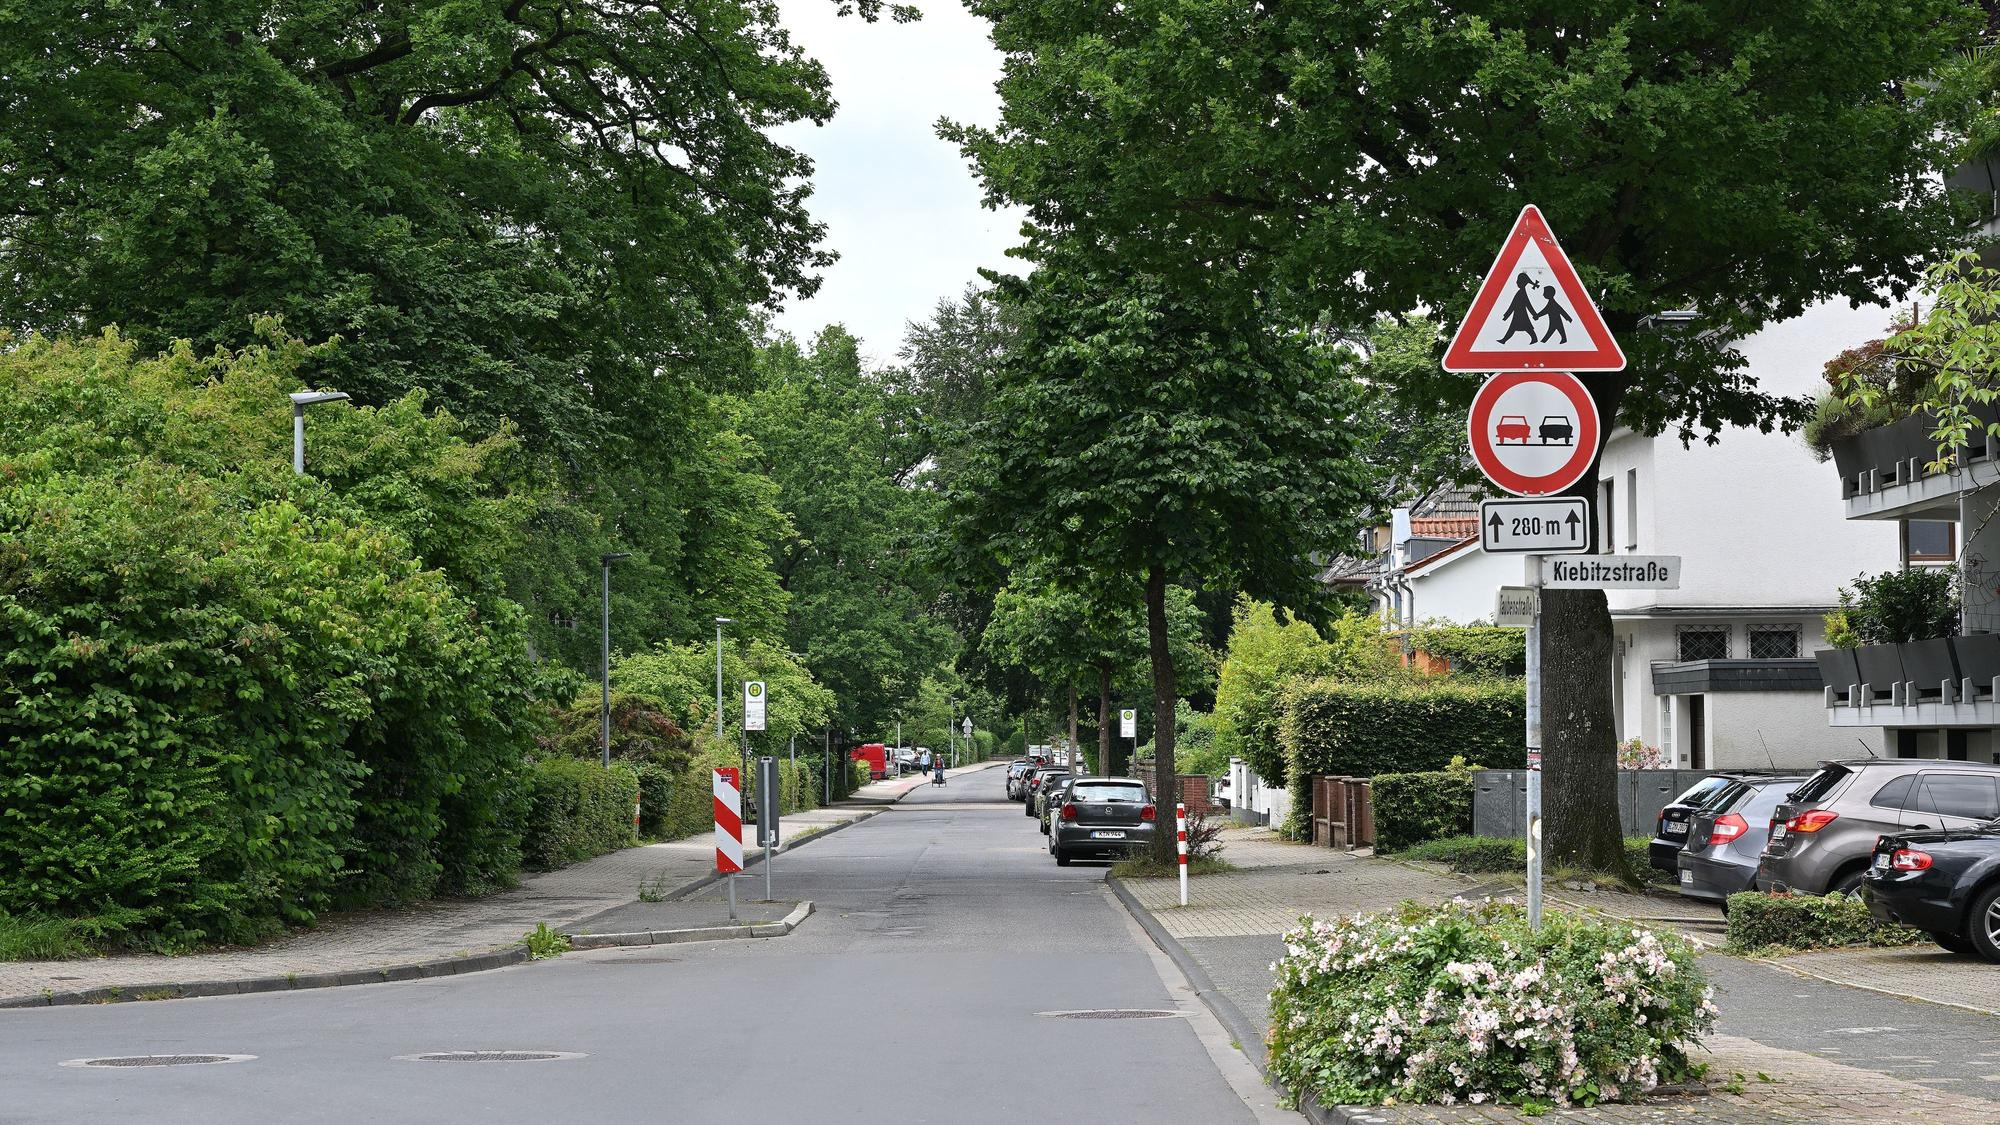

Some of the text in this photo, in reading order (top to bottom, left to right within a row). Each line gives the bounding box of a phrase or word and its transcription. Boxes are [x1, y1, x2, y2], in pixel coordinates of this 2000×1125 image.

[1512, 517, 1561, 536] 280 m
[1553, 561, 1668, 582] Kiebitzstraße
[751, 686, 759, 694] H
